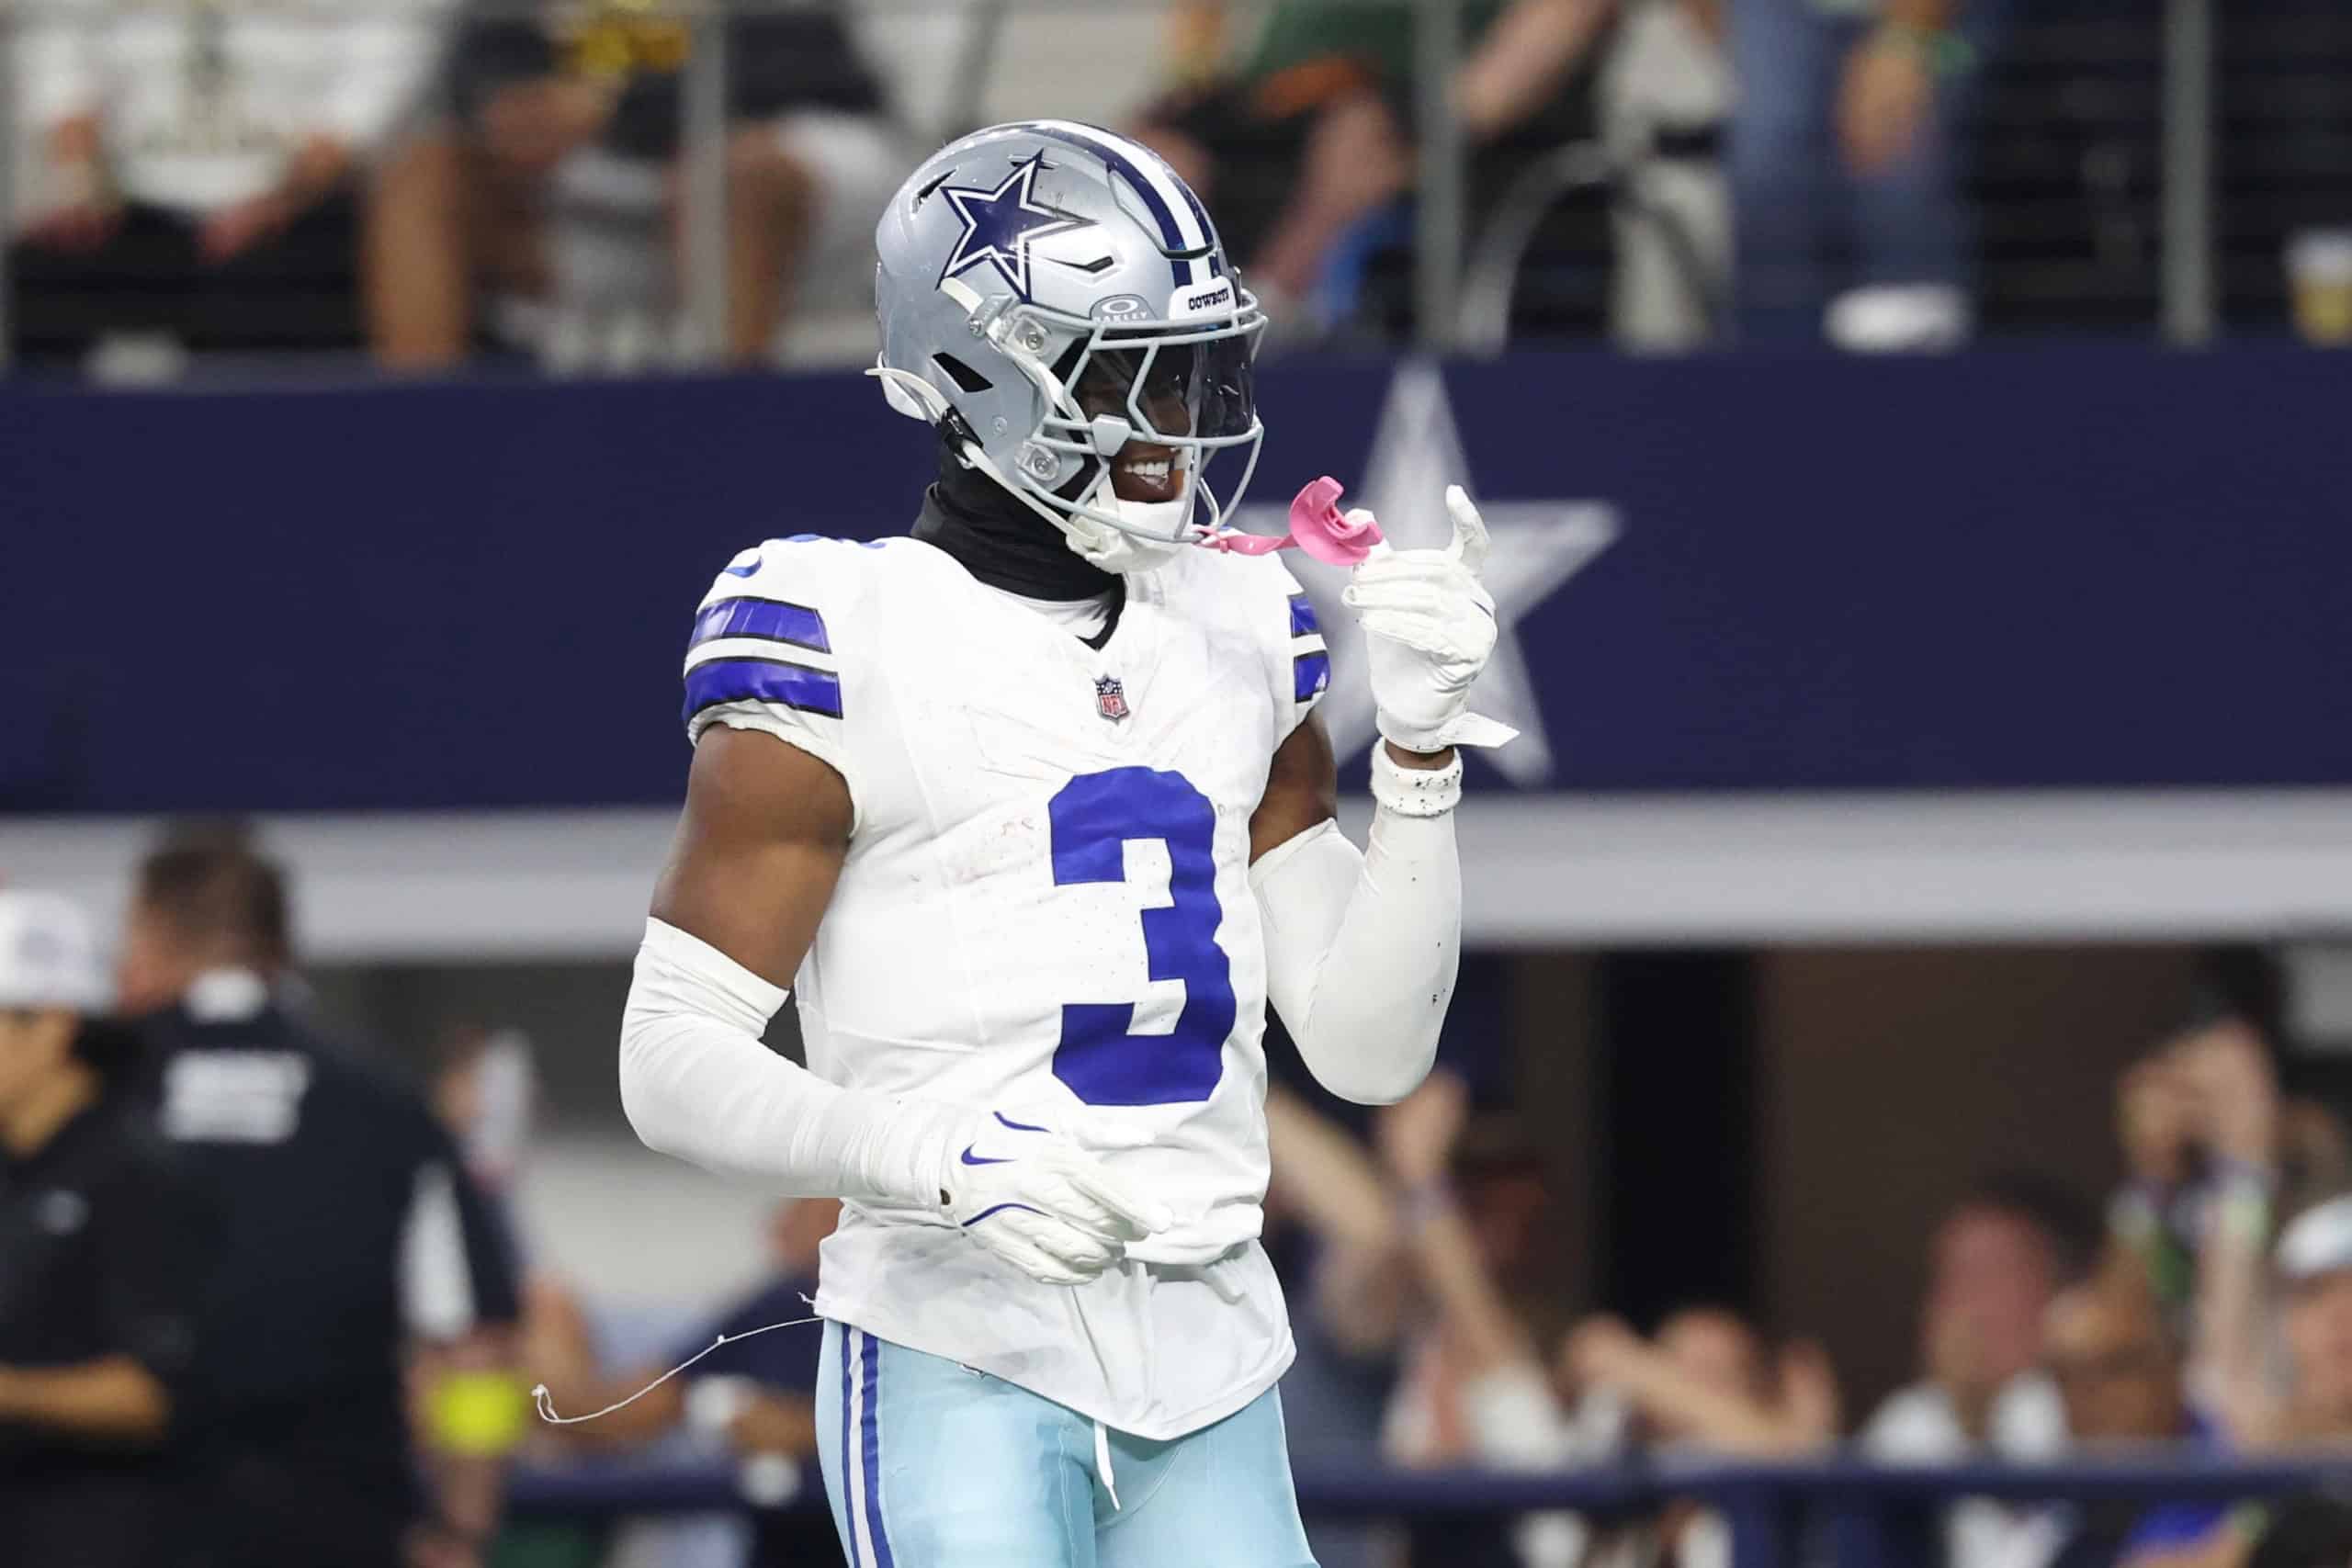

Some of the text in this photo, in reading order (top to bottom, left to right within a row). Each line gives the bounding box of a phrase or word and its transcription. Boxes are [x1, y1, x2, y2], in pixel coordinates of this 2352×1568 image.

[1188, 288, 1230, 310] COWBOYS
[1101, 694, 1127, 716] NFL
[1047, 765, 1237, 1106] 3
